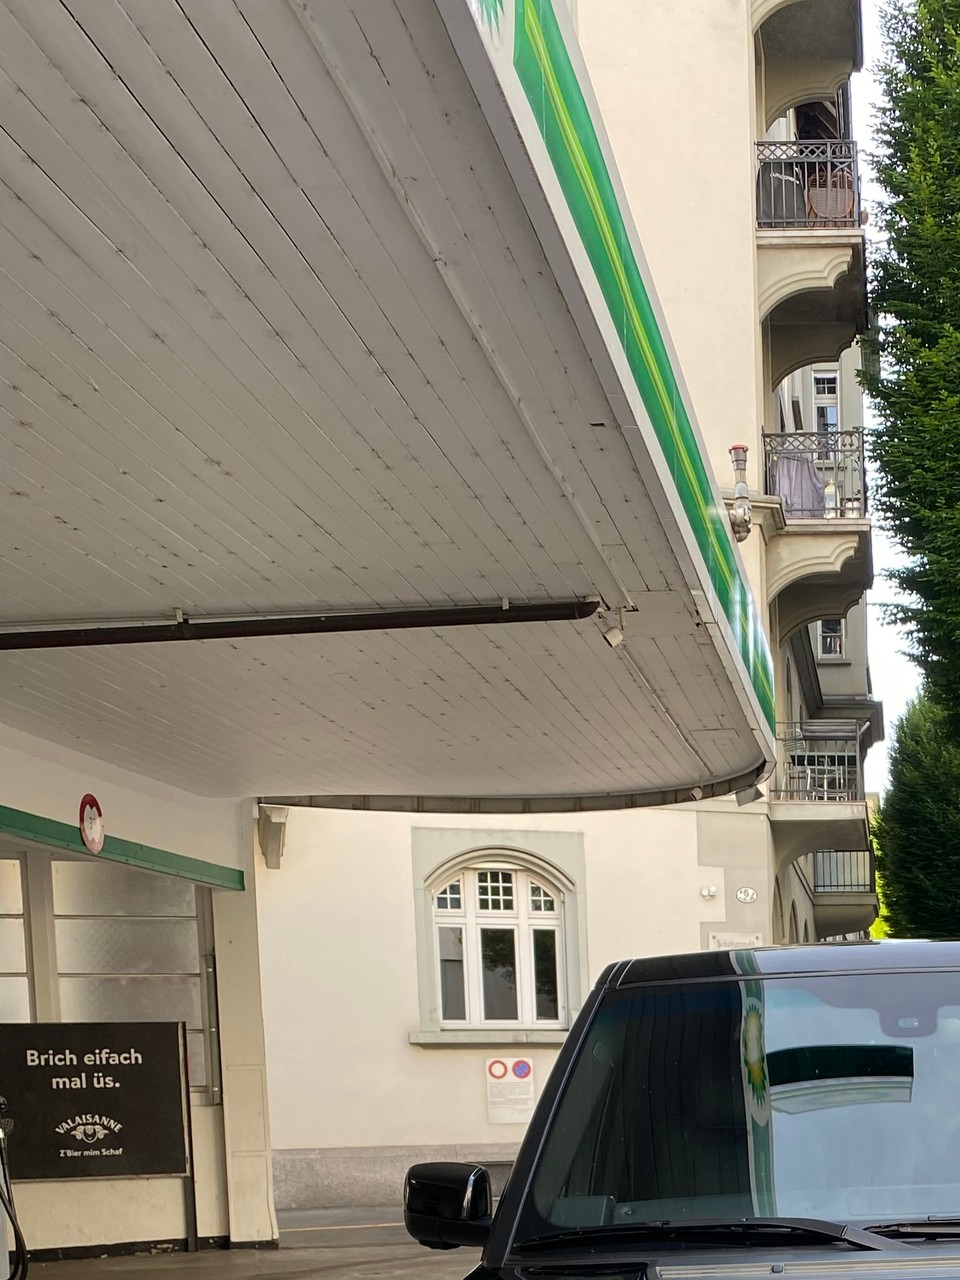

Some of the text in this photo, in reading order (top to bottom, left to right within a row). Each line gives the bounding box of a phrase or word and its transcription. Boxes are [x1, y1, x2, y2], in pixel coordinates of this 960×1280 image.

[26, 1048, 143, 1066] Brich eifach
[52, 1072, 121, 1089] mal üs.
[55, 1113, 123, 1134] VALAISANNE
[101, 1147, 123, 1156] Schaf
